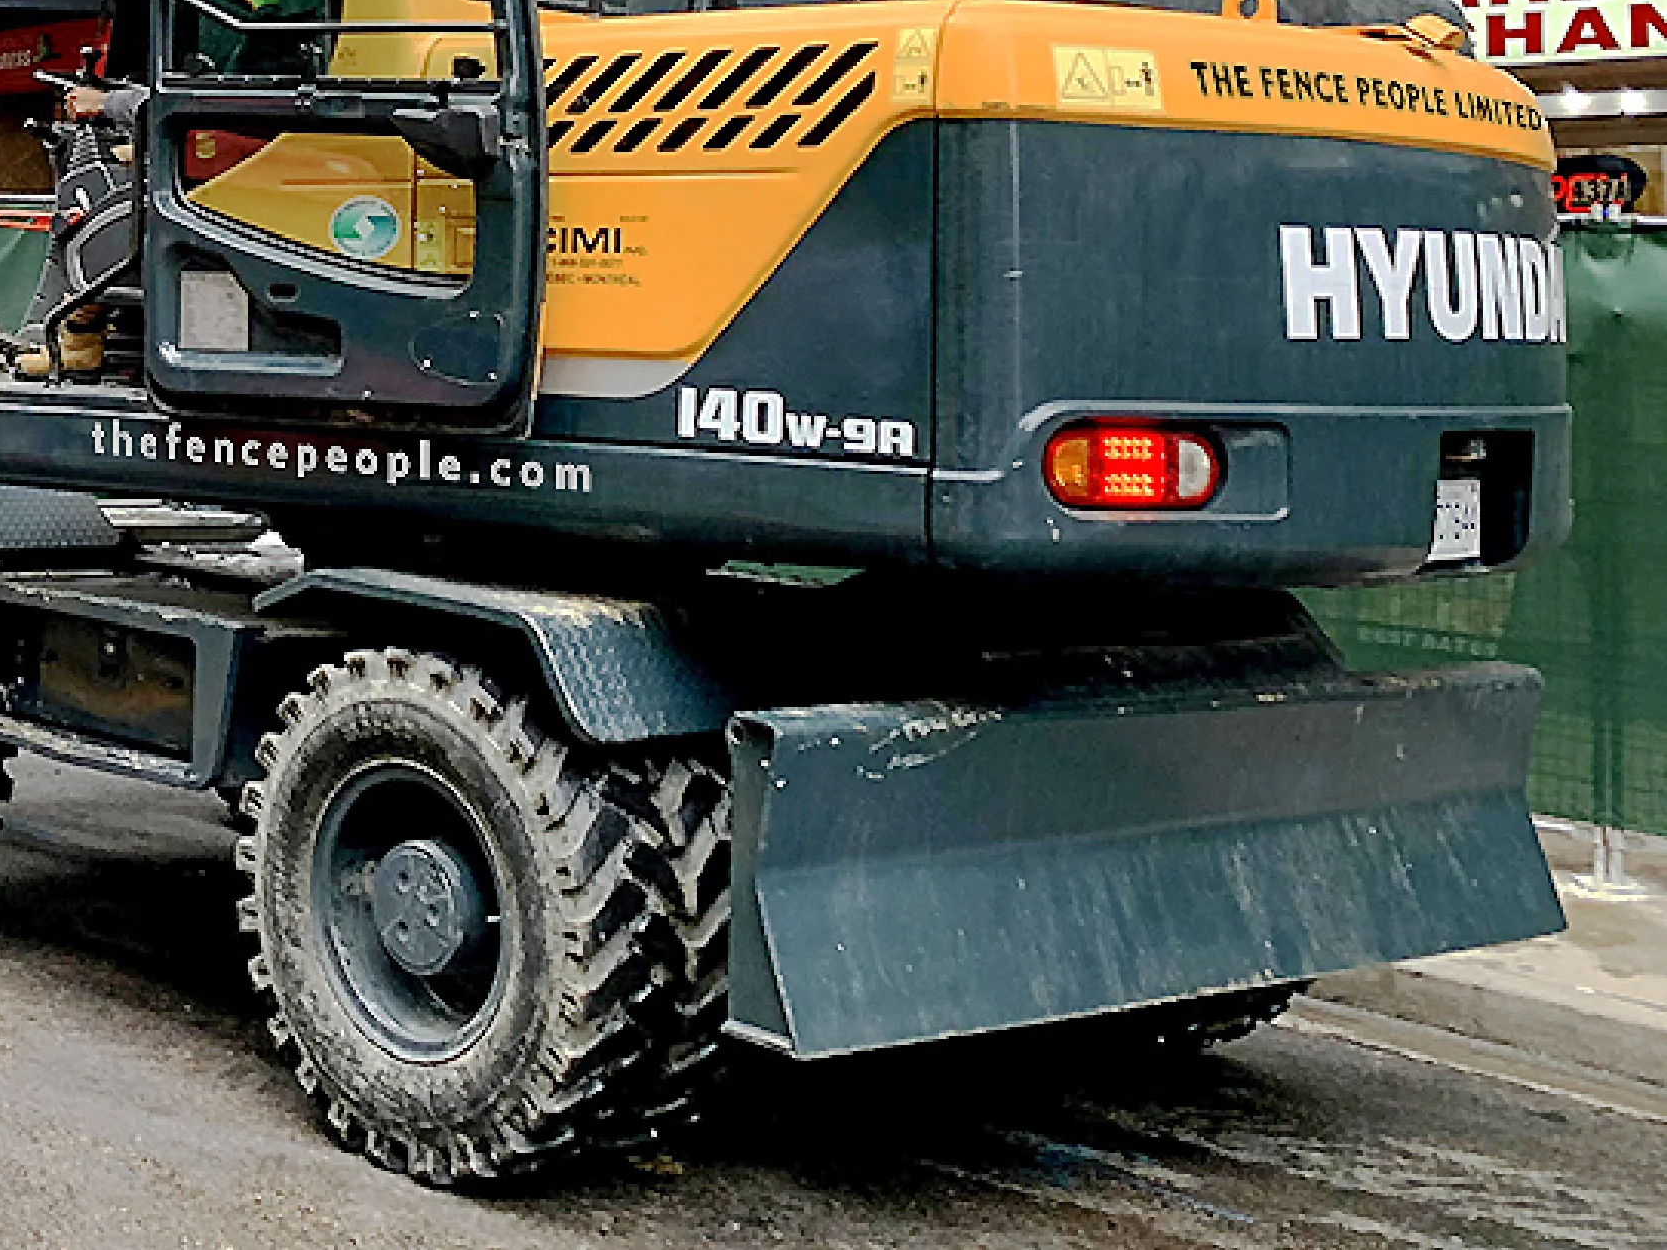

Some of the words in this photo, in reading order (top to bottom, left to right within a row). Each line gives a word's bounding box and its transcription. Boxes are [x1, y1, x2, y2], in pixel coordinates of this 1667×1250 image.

[1190, 60, 1254, 98] THE
[1259, 66, 1350, 105] FENCE
[1355, 76, 1448, 116] PEOPLE
[1453, 90, 1543, 131] LIMITED
[91, 420, 594, 493] thefencepeople.com
